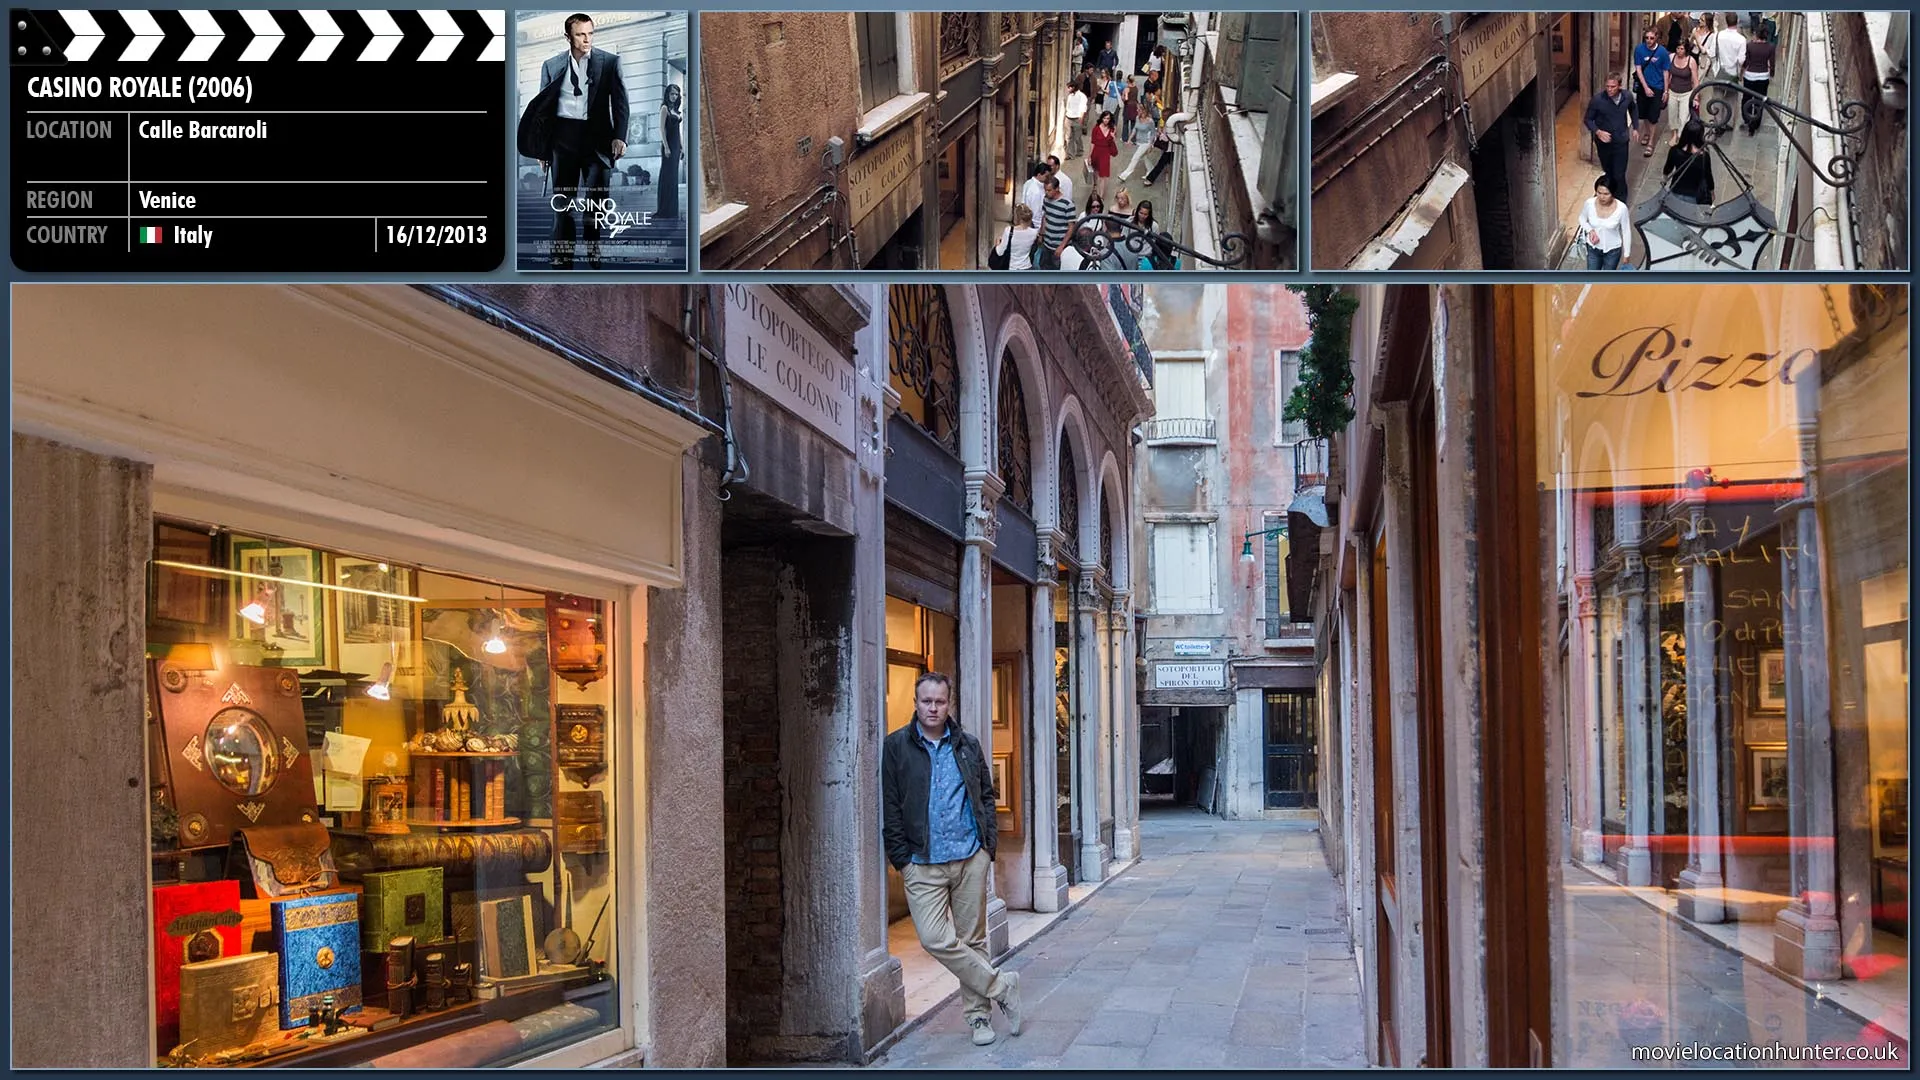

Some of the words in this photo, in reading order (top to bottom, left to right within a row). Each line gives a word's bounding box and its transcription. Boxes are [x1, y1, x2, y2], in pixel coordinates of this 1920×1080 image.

[1472, 59, 1484, 80] LE
[550, 193, 617, 213] CASINO
[859, 187, 872, 209] LE
[594, 211, 652, 230] ROYALE
[726, 284, 834, 382] SOTOPORTEGO
[747, 336, 767, 373] LE
[776, 359, 843, 427] COLONNE
[1157, 665, 1221, 673] SOTOPORTEGO
